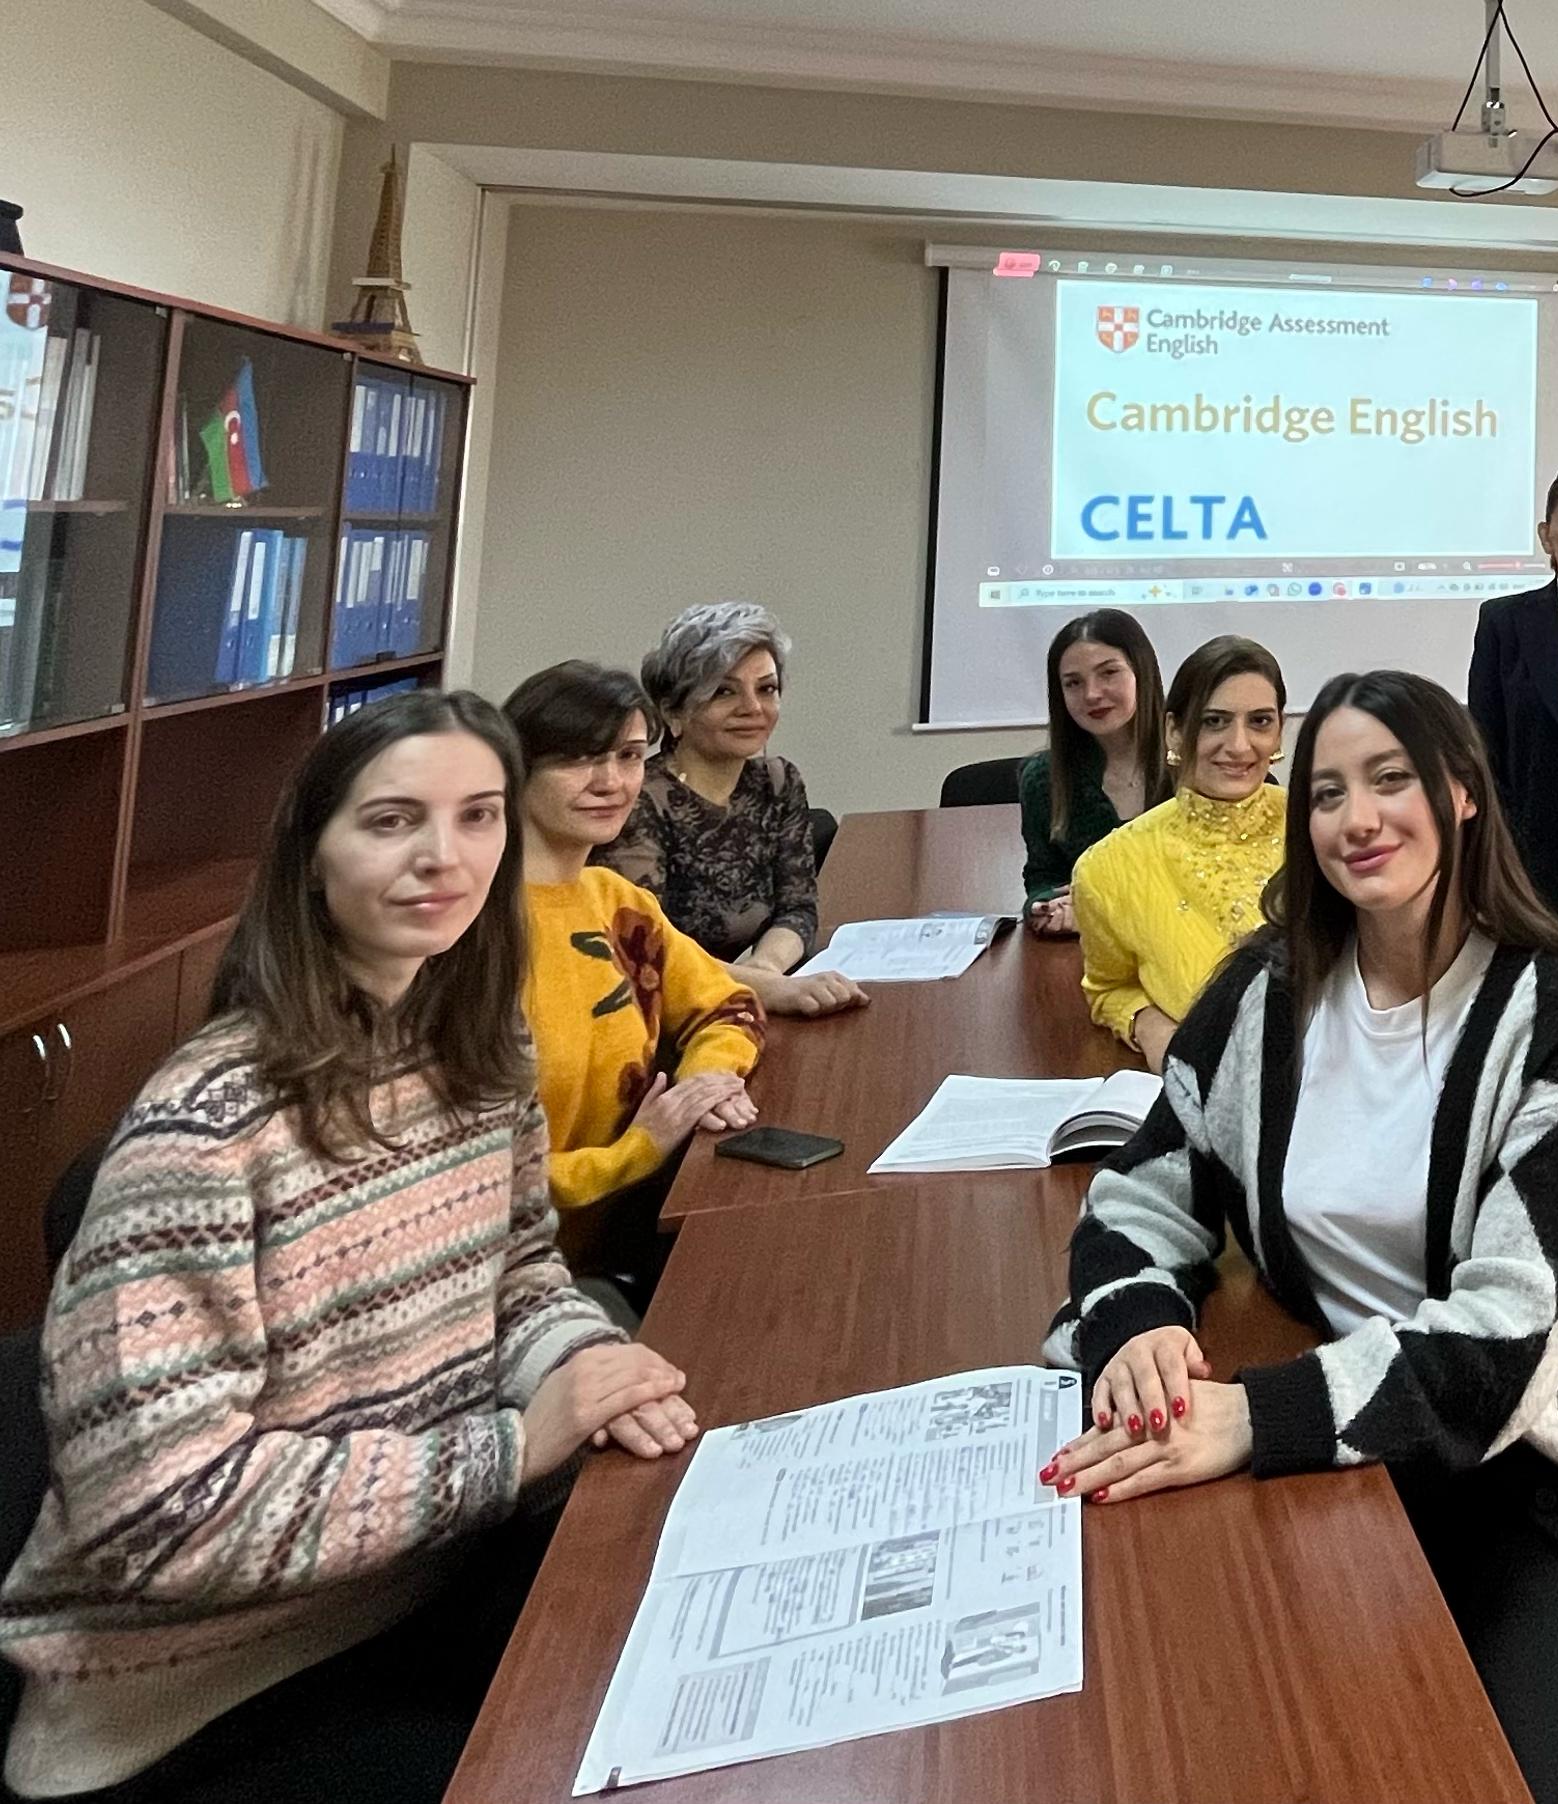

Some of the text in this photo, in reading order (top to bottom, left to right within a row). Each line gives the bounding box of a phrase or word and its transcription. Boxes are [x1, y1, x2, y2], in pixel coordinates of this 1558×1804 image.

[1146, 308, 1391, 337] Cambridge Assessment
[1146, 333, 1219, 360] English
[1086, 391, 1498, 445] Cambridge English
[1080, 494, 1269, 542] CELTA
